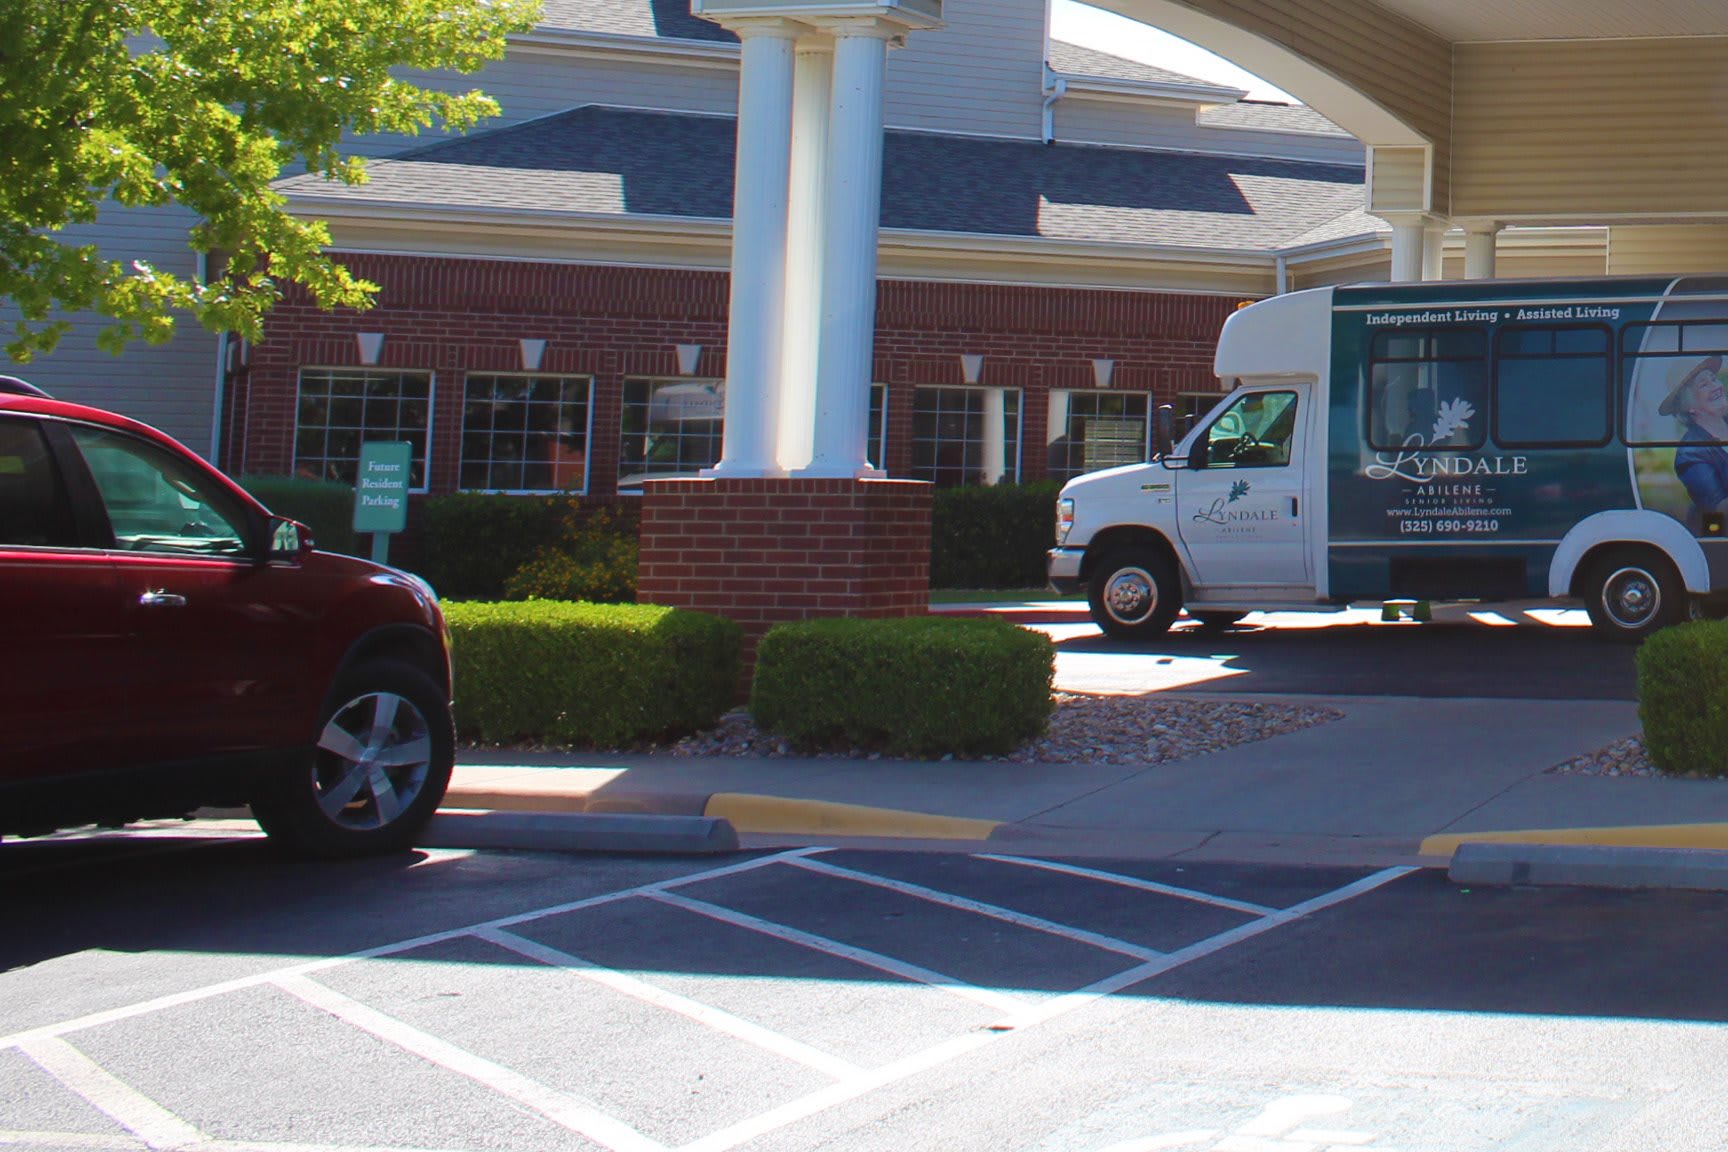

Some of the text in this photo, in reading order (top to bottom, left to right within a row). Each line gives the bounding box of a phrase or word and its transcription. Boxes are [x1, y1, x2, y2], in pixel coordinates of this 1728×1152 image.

[1366, 306, 1620, 326] Independent Living Assisted Living
[1365, 433, 1528, 483] LYNDALE
[368, 461, 400, 472] Future
[362, 478, 403, 489] Resident
[1416, 484, 1482, 496] ABILENE
[362, 495, 400, 510] Parking
[1192, 497, 1279, 525] LYNDALE
[1386, 507, 1512, 518] www.LyndaleAbilene.com
[1400, 519, 1499, 533] (325) 690-9210
